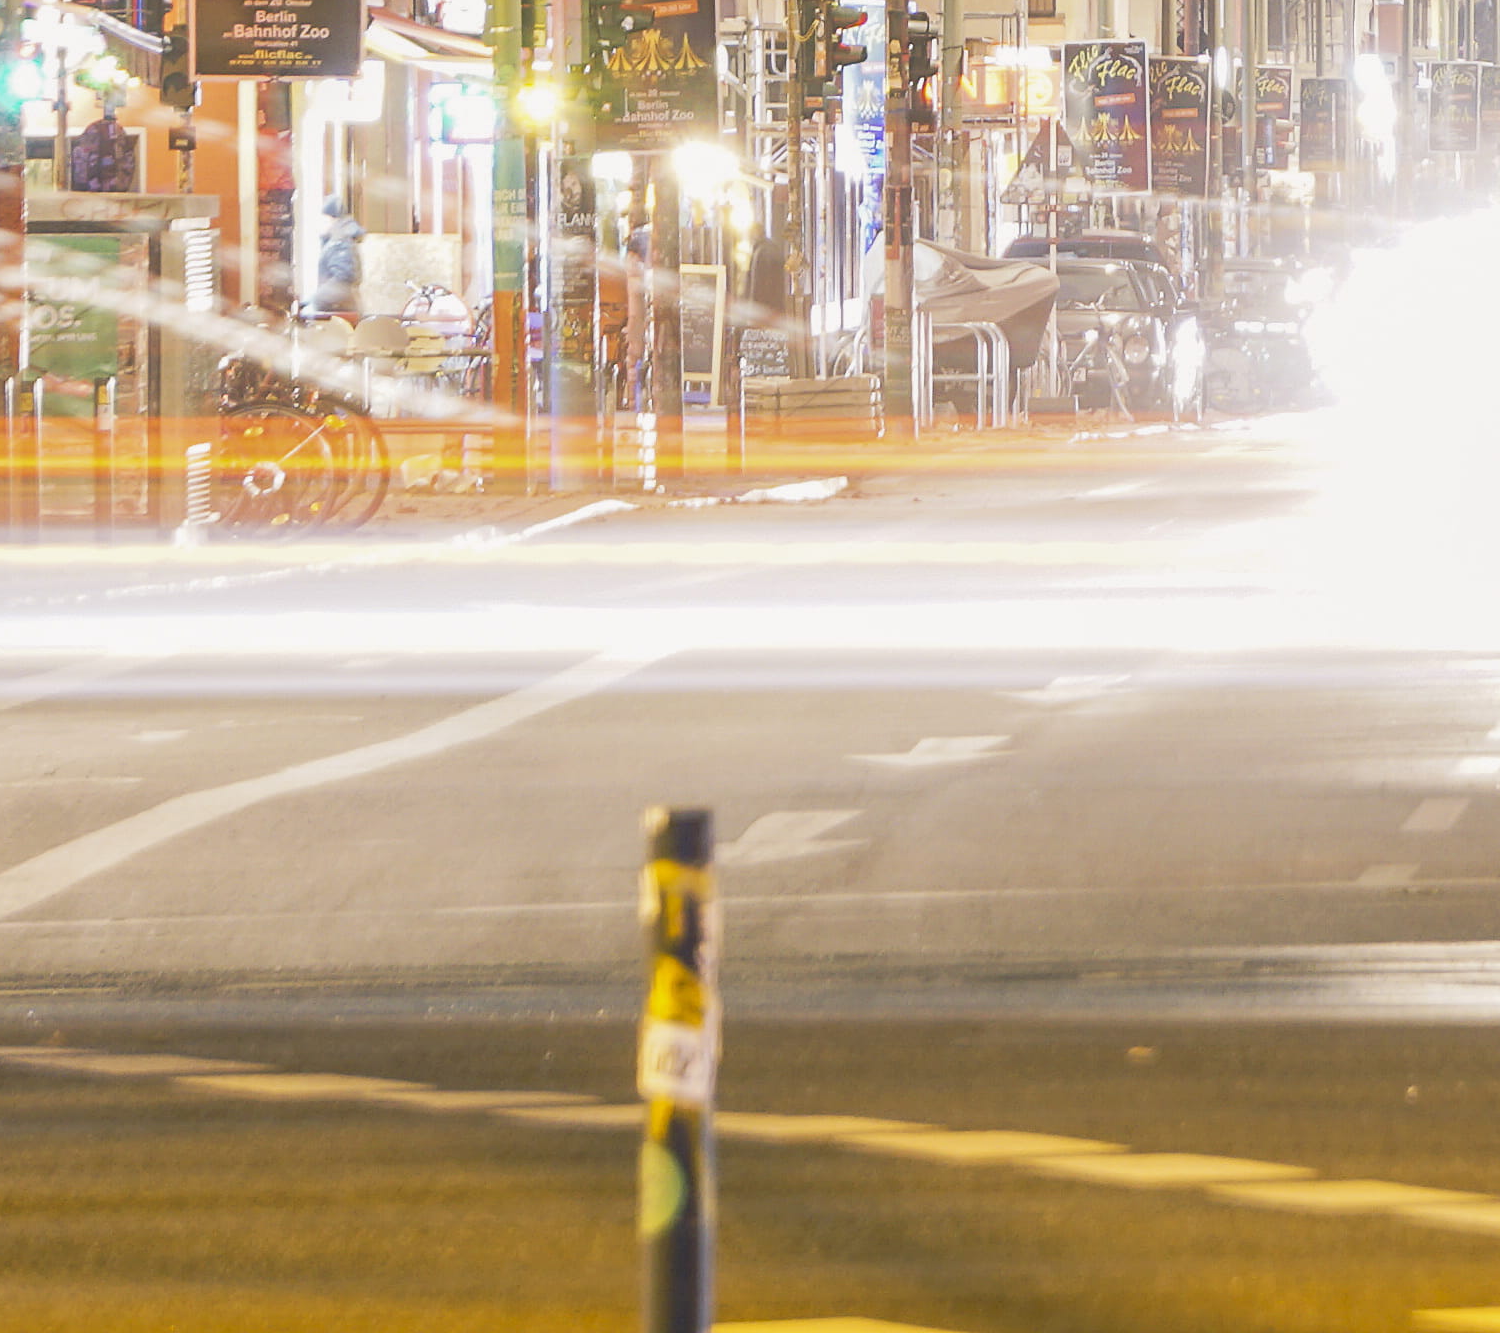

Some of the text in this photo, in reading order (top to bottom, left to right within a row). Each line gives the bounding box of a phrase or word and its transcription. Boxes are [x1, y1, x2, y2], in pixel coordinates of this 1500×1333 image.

[255, 9, 297, 23] Berlin
[233, 24, 297, 39] Bahnhof
[299, 24, 330, 39] Zoo
[1095, 60, 1137, 87] Flac
[672, 110, 694, 121] Zoo
